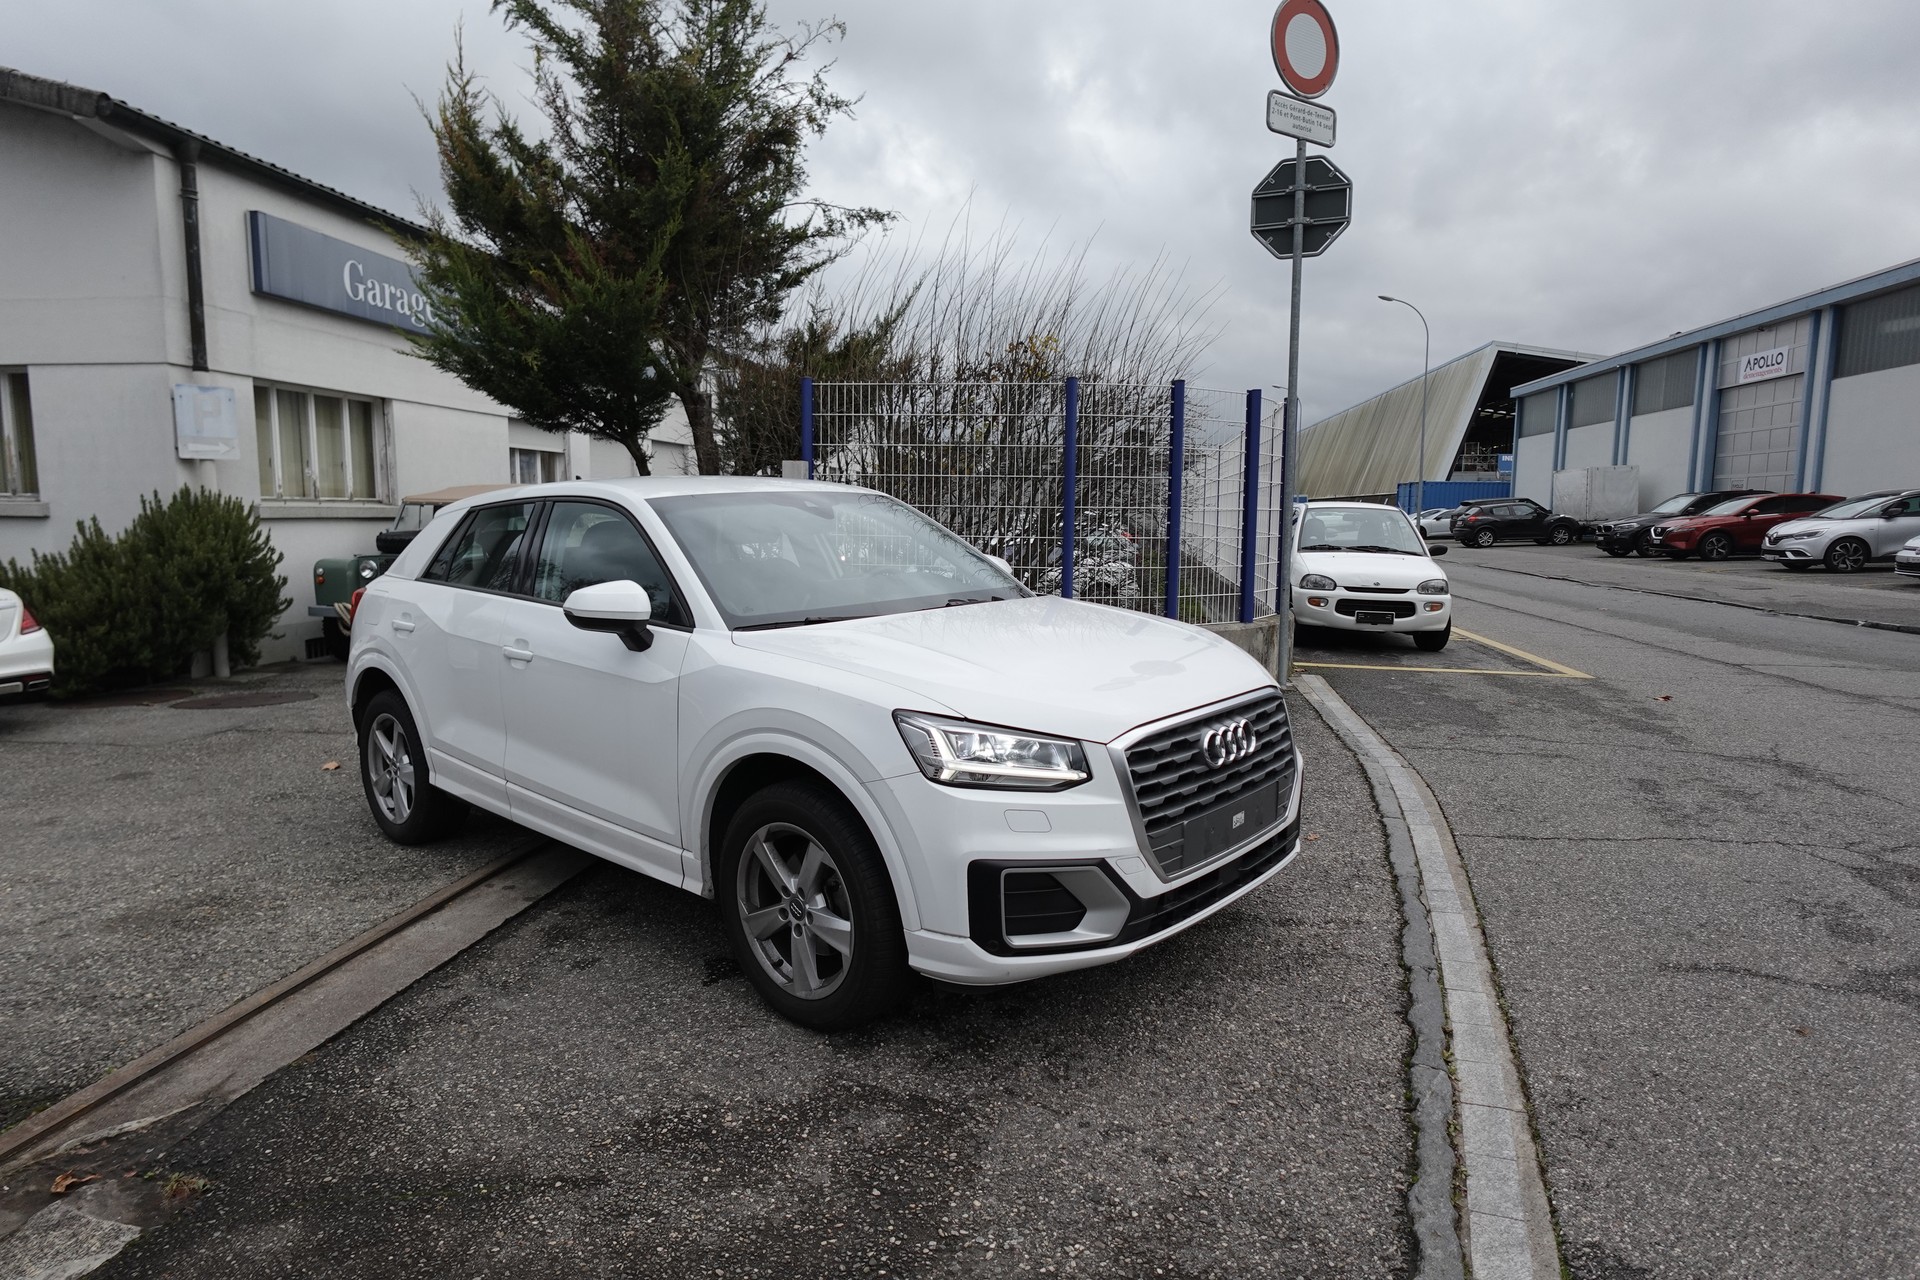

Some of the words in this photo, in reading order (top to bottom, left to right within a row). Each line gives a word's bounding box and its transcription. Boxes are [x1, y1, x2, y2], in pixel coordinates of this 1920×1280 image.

[1274, 100, 1289, 109] Accès
[1271, 107, 1283, 116] 2-16
[1290, 113, 1315, 125] Pont-Butin
[1292, 123, 1313, 133] autorisé
[1744, 352, 1784, 372] APOLLO
[193, 394, 221, 435] P
